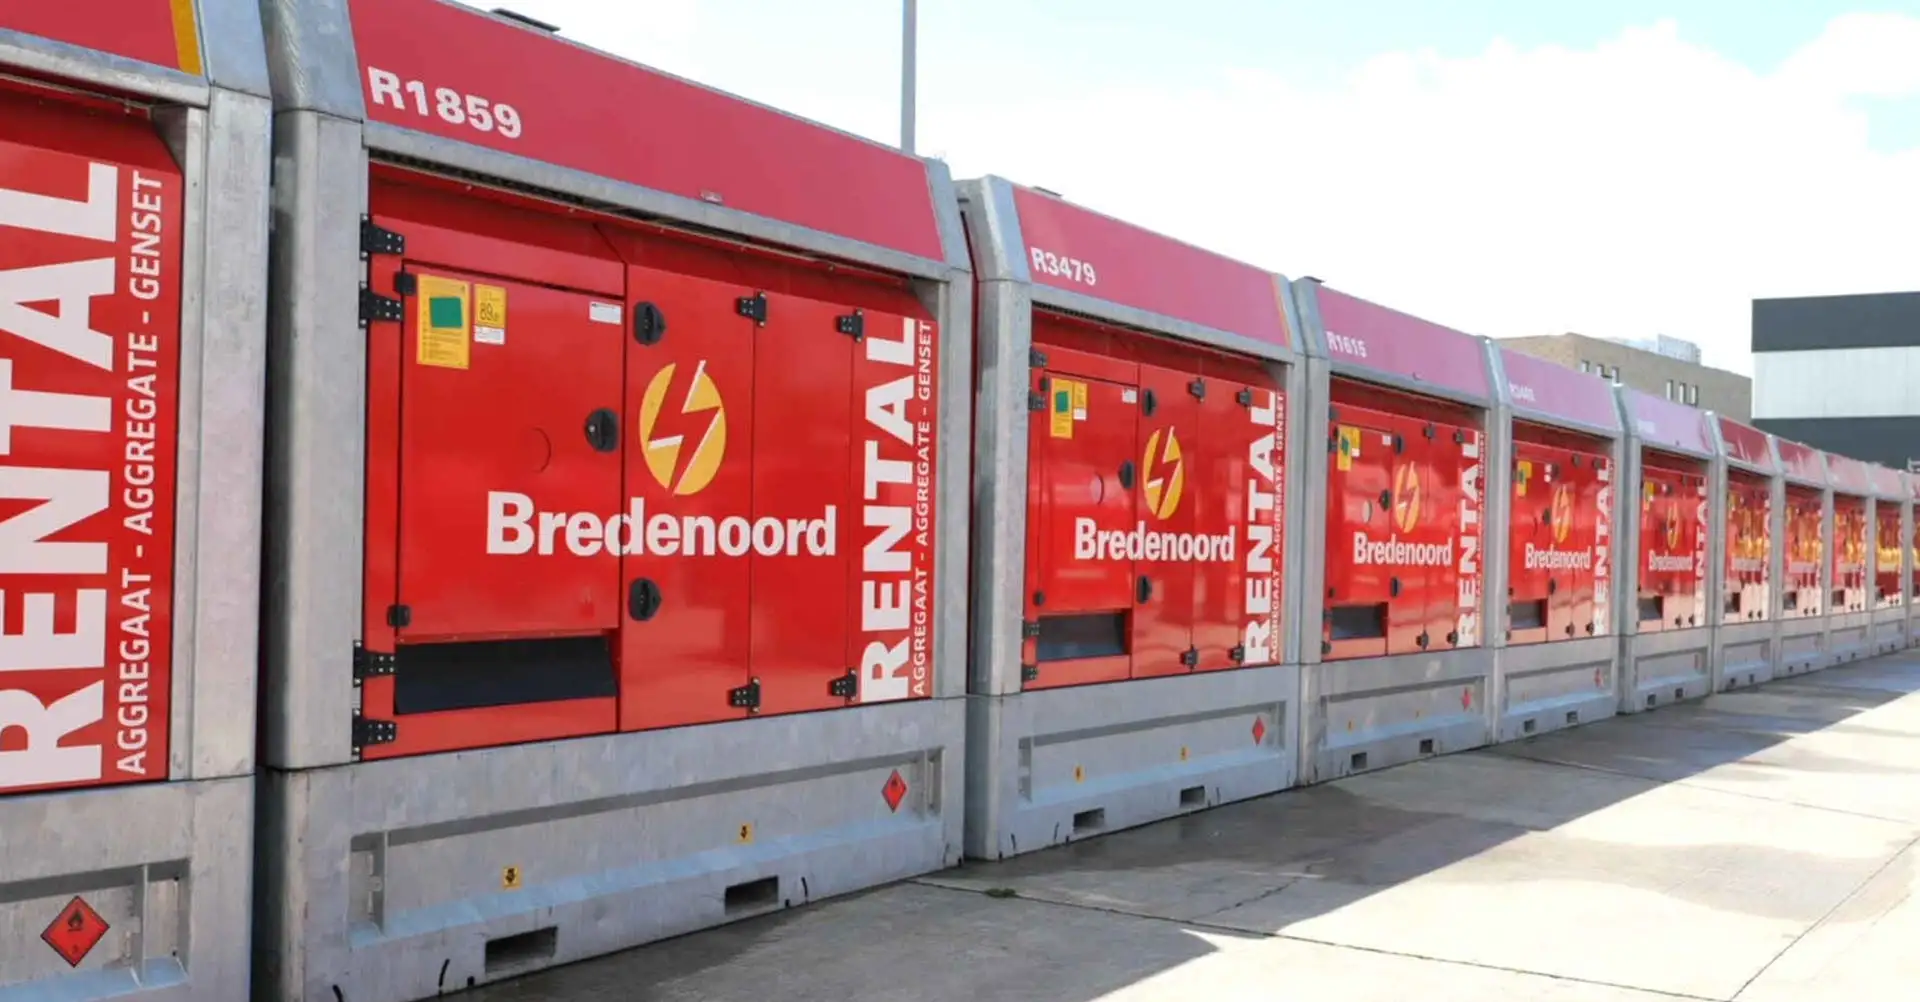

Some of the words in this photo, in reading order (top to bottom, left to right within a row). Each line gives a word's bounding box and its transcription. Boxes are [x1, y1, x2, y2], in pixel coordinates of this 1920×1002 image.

[367, 66, 522, 138] R1859
[130, 170, 162, 300] GENSET
[1030, 246, 1097, 286] R3479
[918, 320, 931, 401] GENSET
[0, 162, 118, 787] RENTAL
[124, 333, 158, 534] AGGREGATE
[916, 421, 930, 546] AGGREGATE
[486, 490, 836, 557] Bredenoord
[860, 317, 914, 701] RENTAL
[1074, 517, 1235, 561] Bredenoord
[1245, 391, 1276, 663] RENTAL
[1353, 532, 1452, 566] Bredenoord
[1456, 430, 1478, 647] RENTAL
[116, 568, 152, 774] AGGREGAAT
[913, 566, 927, 695] AGGREGAAT
